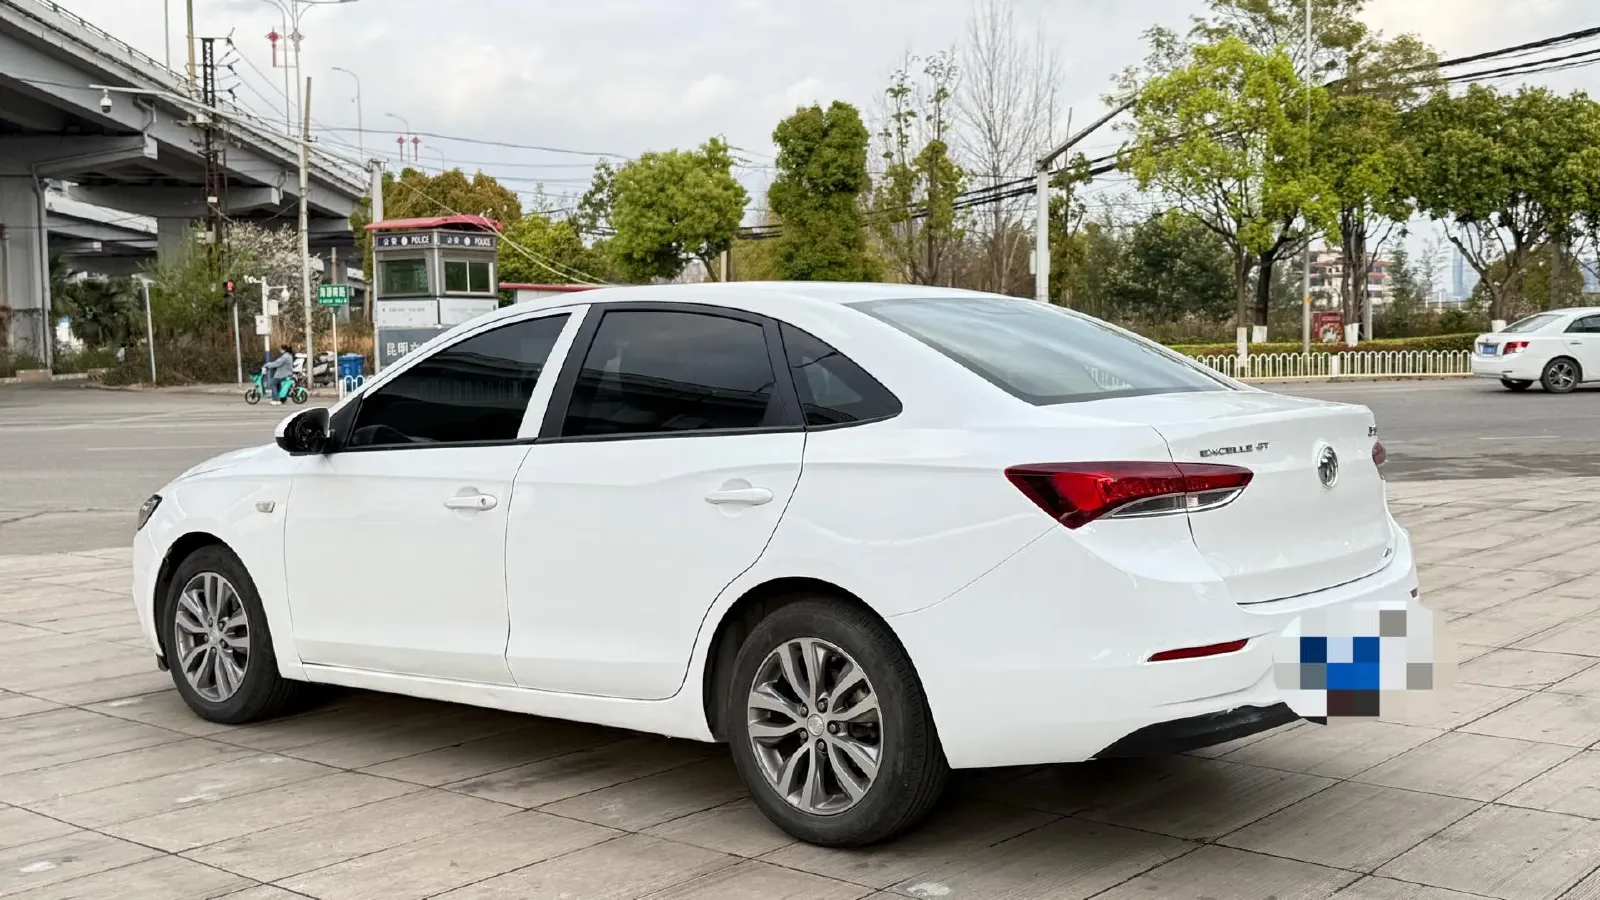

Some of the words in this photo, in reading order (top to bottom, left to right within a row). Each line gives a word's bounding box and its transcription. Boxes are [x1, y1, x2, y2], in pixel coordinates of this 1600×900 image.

[411, 235, 430, 244] POLICE
[474, 237, 491, 246] POLICE
[1199, 444, 1253, 458] EXCELLE
